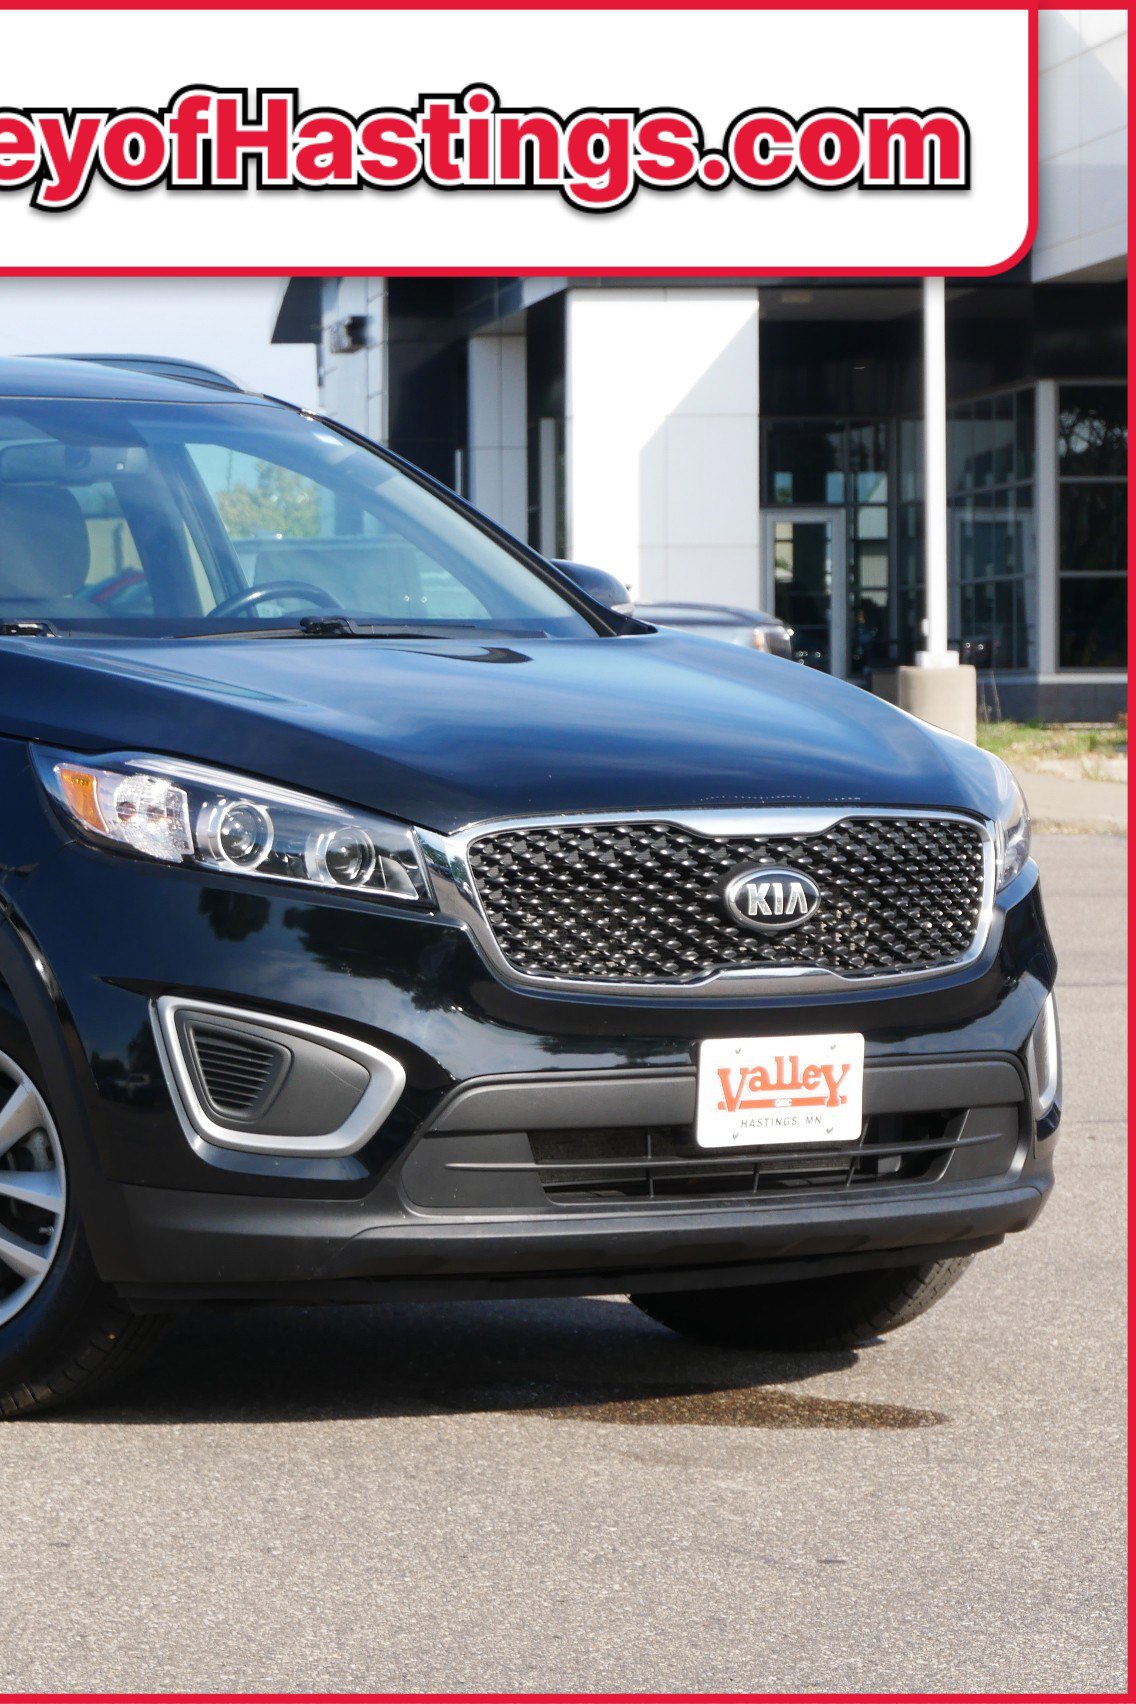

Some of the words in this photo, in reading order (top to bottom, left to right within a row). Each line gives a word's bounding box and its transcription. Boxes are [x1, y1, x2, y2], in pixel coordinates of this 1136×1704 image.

[745, 882, 809, 915] KIA
[717, 1055, 851, 1112] Valley
[805, 1115, 822, 1125] MN
